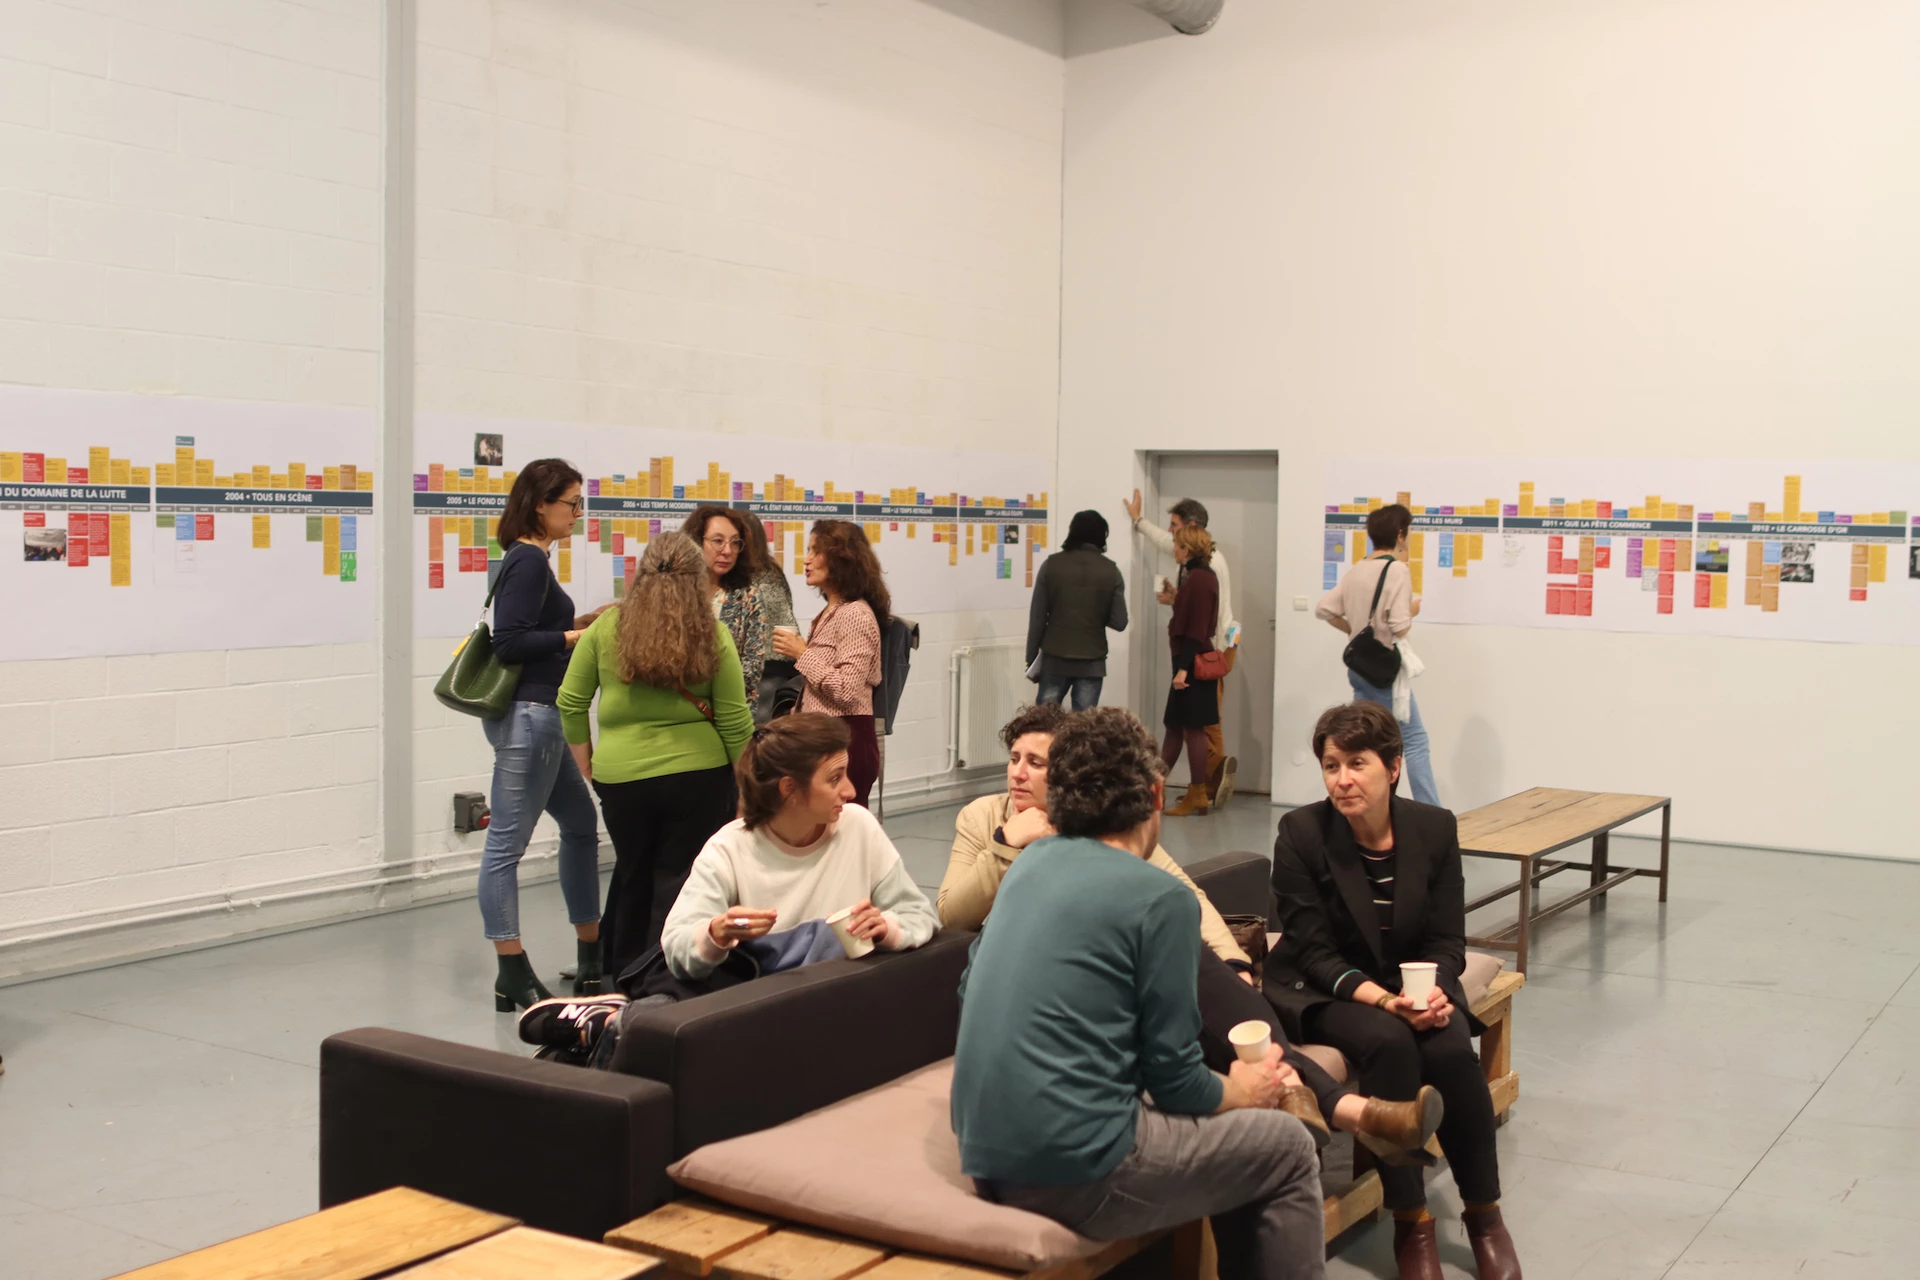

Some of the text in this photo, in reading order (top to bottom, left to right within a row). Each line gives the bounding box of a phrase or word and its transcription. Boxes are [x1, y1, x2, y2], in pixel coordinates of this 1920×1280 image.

[4, 487, 127, 499] DU DOMAINE DE LA LUTTE
[224, 491, 313, 502] 2004 TOUS EN SCÈNE
[468, 497, 476, 505] LE
[477, 497, 496, 505] FOND
[496, 497, 506, 506] DE
[640, 501, 651, 509] LES
[651, 501, 669, 509] TEMPS
[669, 501, 698, 510] MODERNES
[1564, 520, 1580, 528] QUE
[1580, 520, 1590, 528] LA
[1609, 520, 1652, 530] COMMENCE
